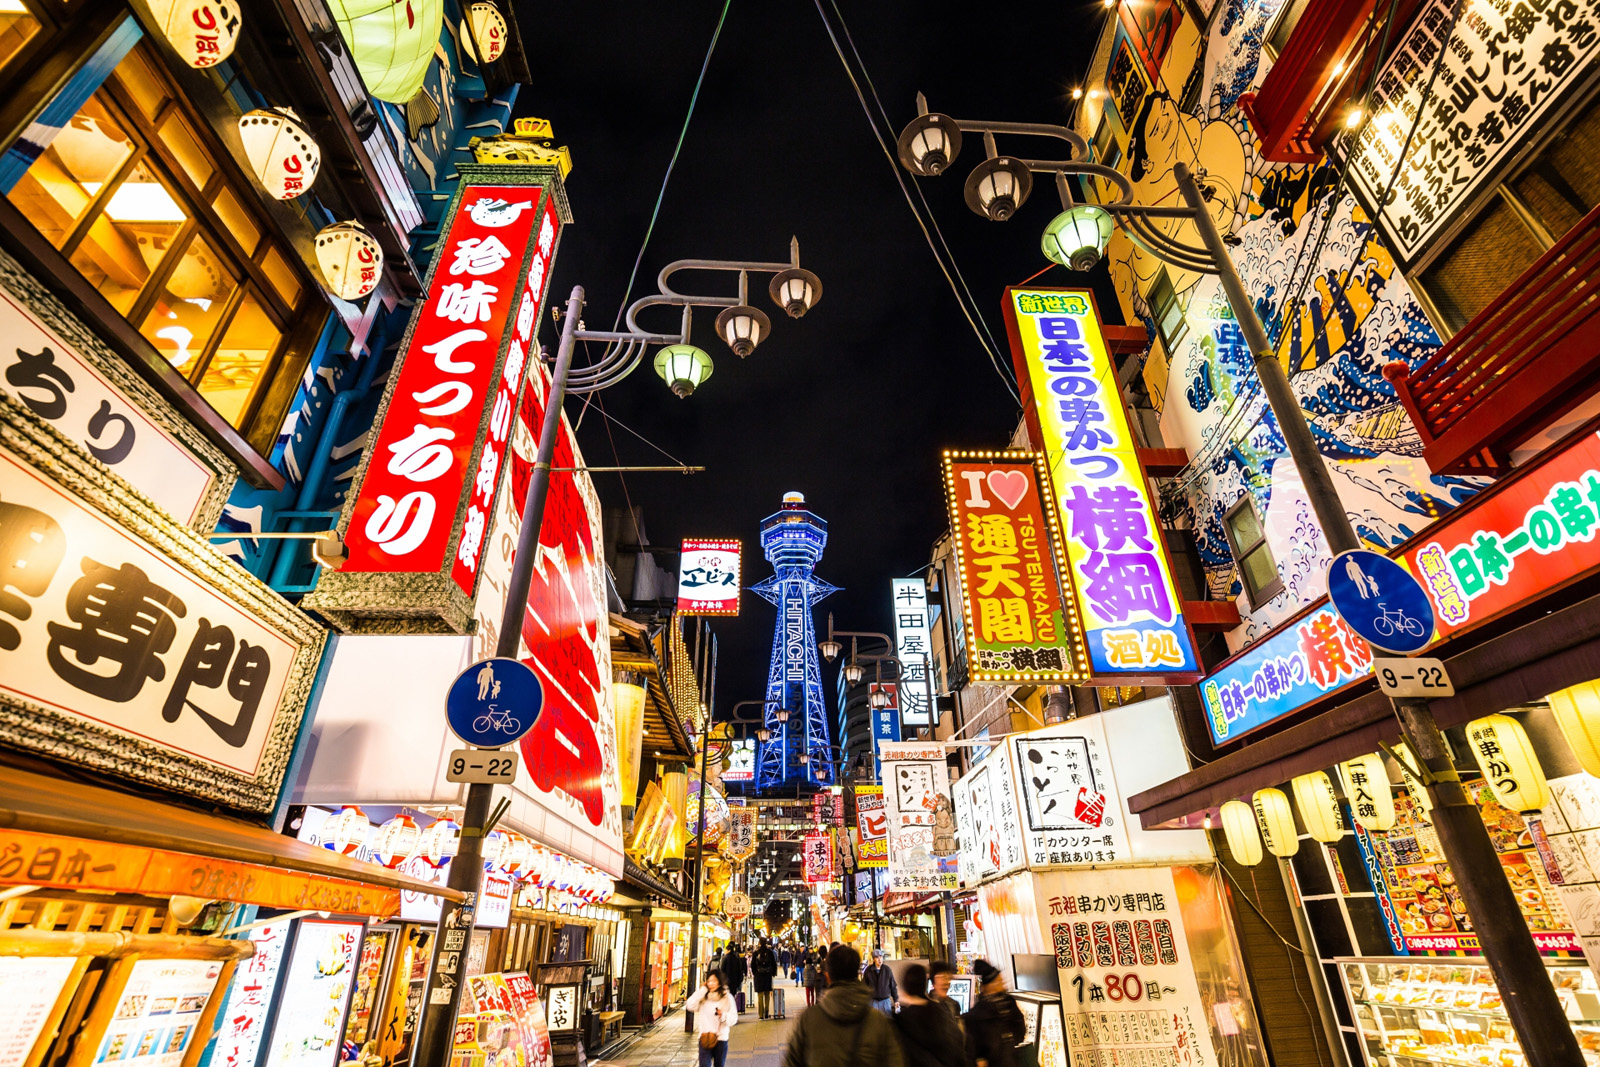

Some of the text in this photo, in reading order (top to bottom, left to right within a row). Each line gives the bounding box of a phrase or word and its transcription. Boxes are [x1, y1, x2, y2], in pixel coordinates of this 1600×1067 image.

[1482, 33, 1558, 104] れんこん
[1429, 99, 1493, 168] 玉ねぎ
[1445, 79, 1516, 149] 山芋
[1018, 294, 1088, 315] 新世界
[1039, 316, 1120, 480] 日本一の串かつ
[961, 470, 991, 508] I
[681, 568, 736, 588] エビス
[967, 512, 1034, 643] 通天閣
[1018, 513, 1056, 642] TSUTENKAKU
[1066, 485, 1172, 627] 横綱
[1419, 546, 1465, 622] 新世界
[786, 598, 804, 681] HITACHI
[896, 585, 929, 714] 半田屋酒店
[1105, 631, 1184, 667] 酒処
[981, 660, 1011, 669] 串かつ
[1220, 655, 1304, 720] 日本一の串かつ
[1348, 762, 1377, 817] 一串入魂
[1479, 741, 1519, 794] 串かつ
[741, 813, 752, 846] 串かつ
[1049, 850, 1116, 863] 座敷あります
[1048, 892, 1166, 916] 元祖串カツ専門店
[1054, 924, 1073, 968] 大阪名物
[1075, 924, 1093, 967] 串カツ
[1114, 922, 1135, 966] 焼きそば
[1136, 922, 1155, 964] たこ焼き
[1155, 920, 1177, 964] 味自慢
[553, 990, 569, 1028] ぎふや
[1081, 1022, 1090, 1039] ハム
[1161, 1017, 1170, 1036] たこ
